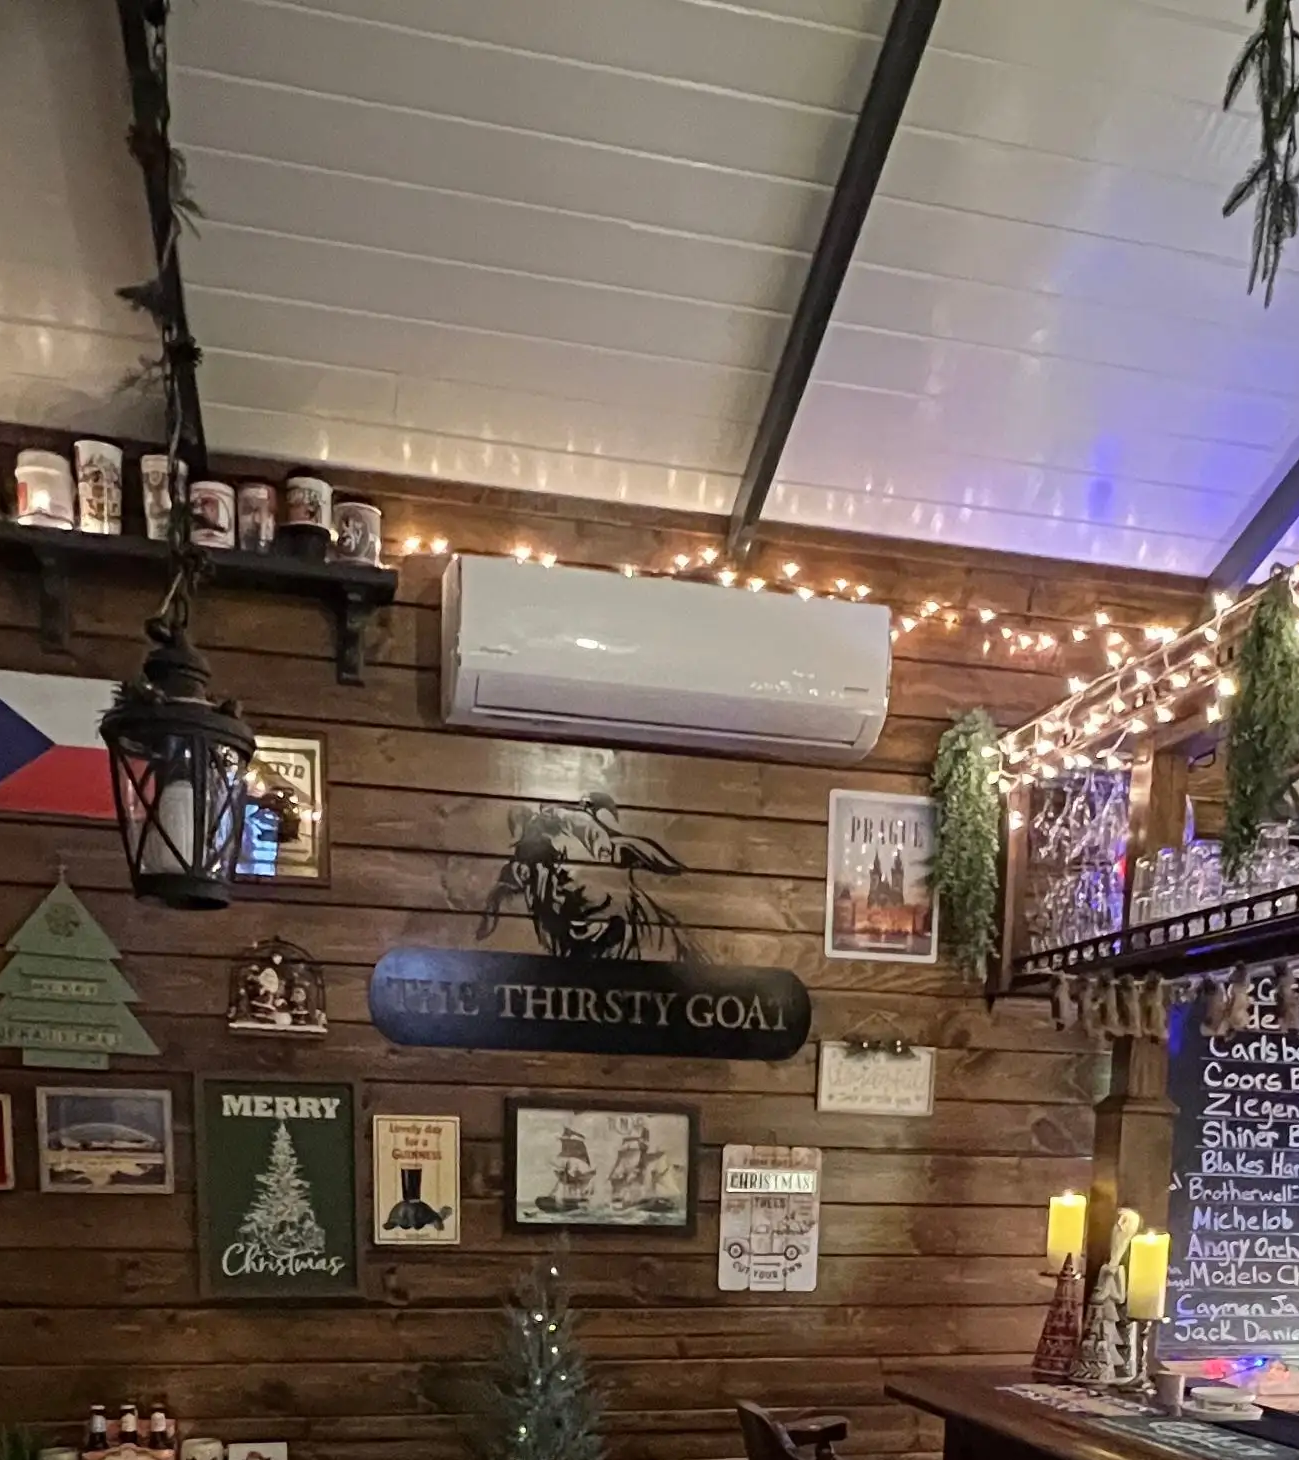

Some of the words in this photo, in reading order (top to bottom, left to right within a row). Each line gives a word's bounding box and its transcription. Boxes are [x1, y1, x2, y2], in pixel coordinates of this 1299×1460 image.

[851, 816, 924, 847] PRAGUE
[387, 976, 480, 1016] THE
[494, 983, 677, 1027] THIRSTY
[686, 994, 793, 1031] GOAT
[1203, 1062, 1282, 1091] Coors
[221, 1094, 340, 1119] MERRY
[1202, 1121, 1279, 1148] Shiner
[730, 1171, 811, 1190] CHRISTMAS
[1193, 1206, 1294, 1231] Michelob
[221, 1242, 346, 1276] Christmas
[1187, 1233, 1250, 1267] Angry
[753, 1270, 778, 1279] YOUR
[1190, 1262, 1272, 1288] Modelo
[1175, 1320, 1237, 1342] Jack
